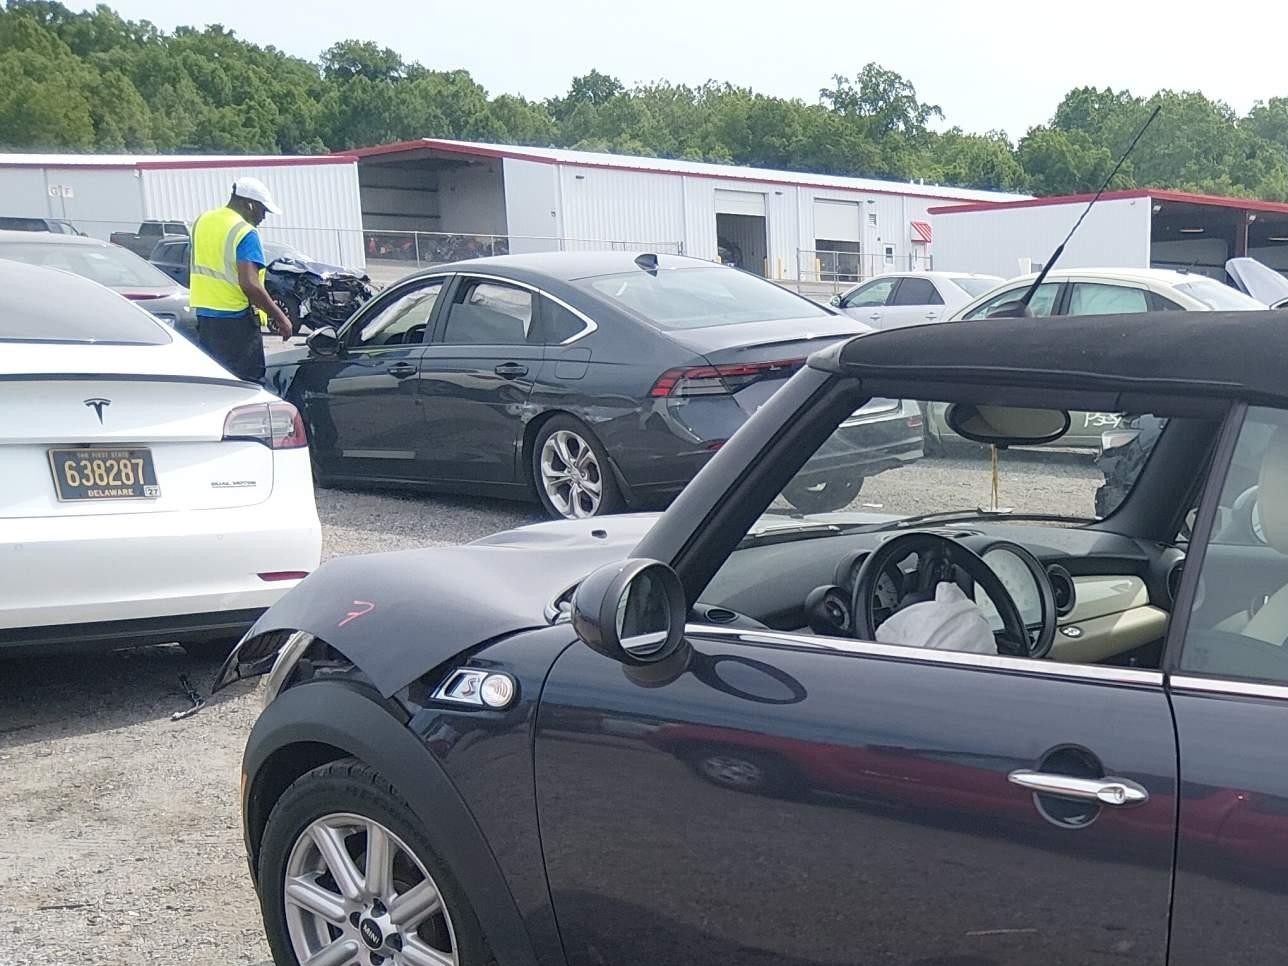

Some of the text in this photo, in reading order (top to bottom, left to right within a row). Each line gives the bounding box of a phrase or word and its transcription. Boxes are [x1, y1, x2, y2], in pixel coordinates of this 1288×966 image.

[64, 459, 145, 487] 638287
[87, 488, 135, 497] DELAWARE
[338, 600, 375, 627] 7
[362, 923, 380, 944] MINI
